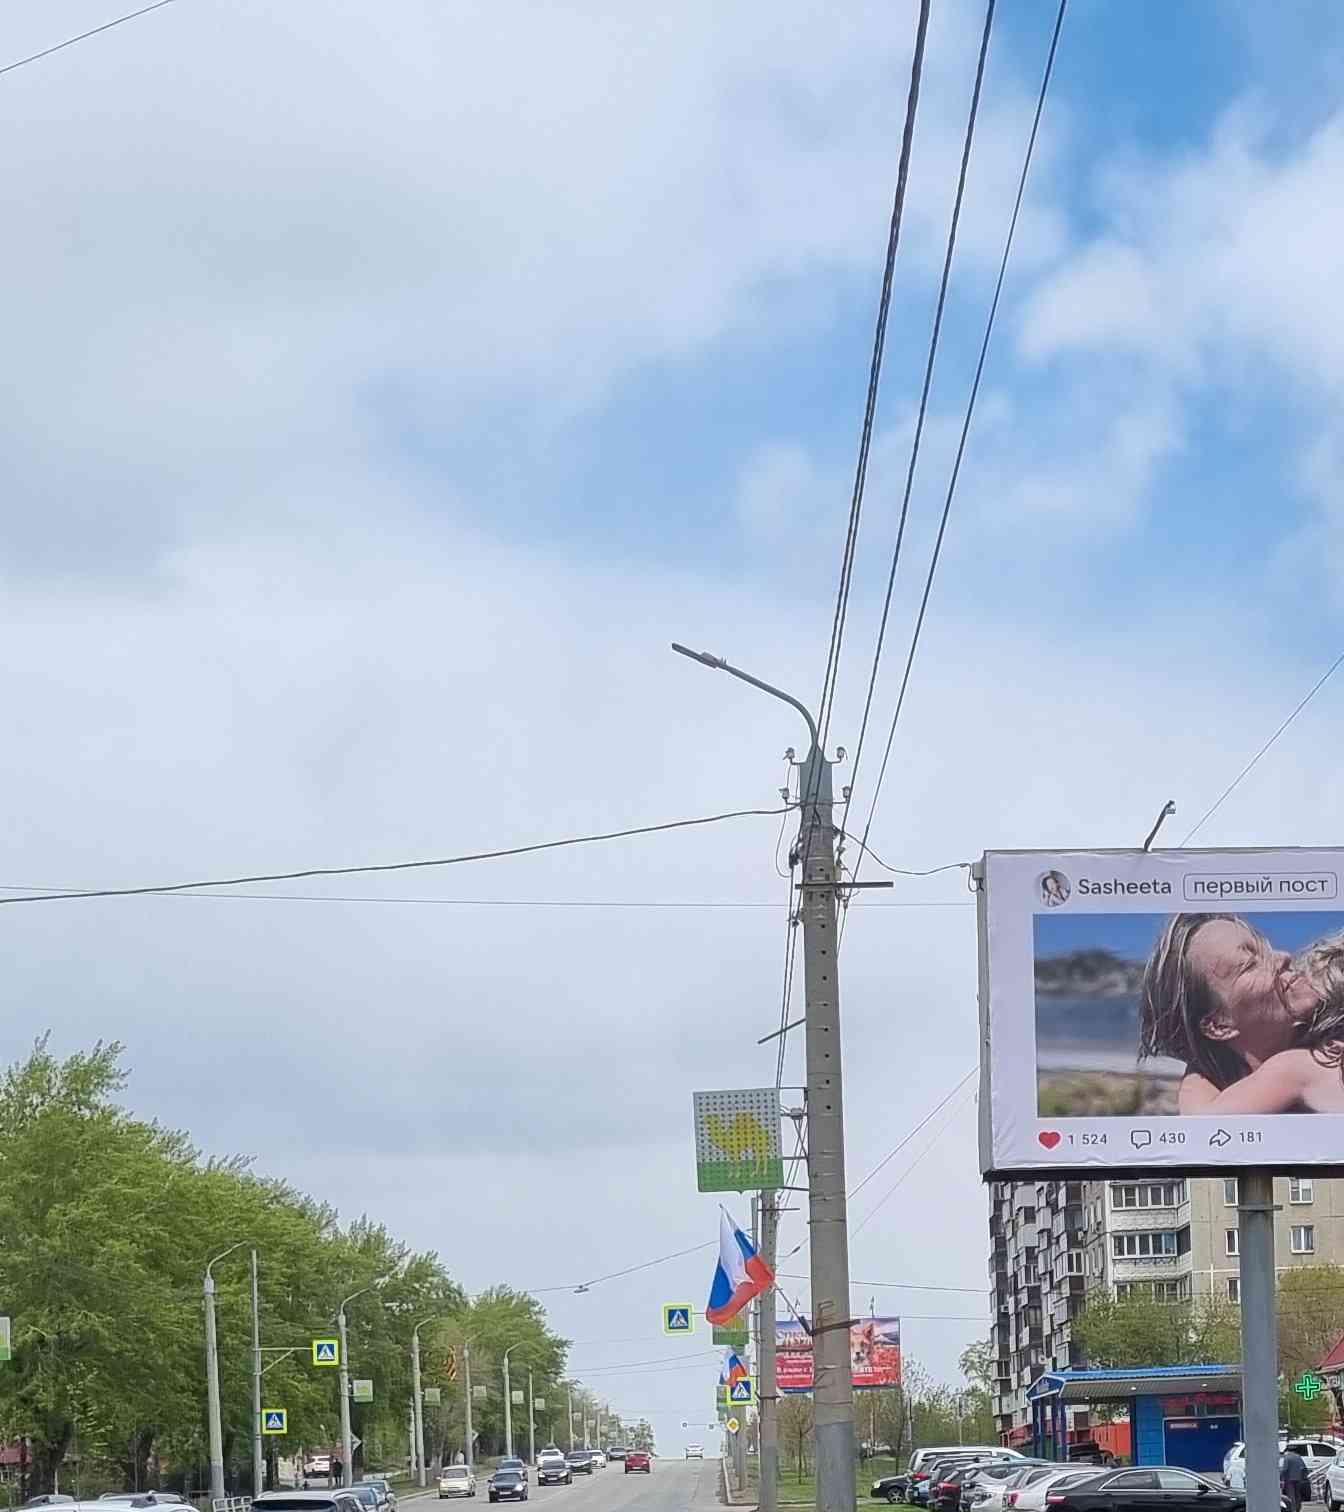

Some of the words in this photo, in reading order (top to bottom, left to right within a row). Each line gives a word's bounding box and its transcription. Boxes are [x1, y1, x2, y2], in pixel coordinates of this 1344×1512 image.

[1078, 878, 1172, 895] Sasheeta
[1193, 876, 1273, 898] первый
[1279, 877, 1329, 893] пост
[1159, 1131, 1186, 1145] 430
[1238, 1130, 1263, 1143] 181
